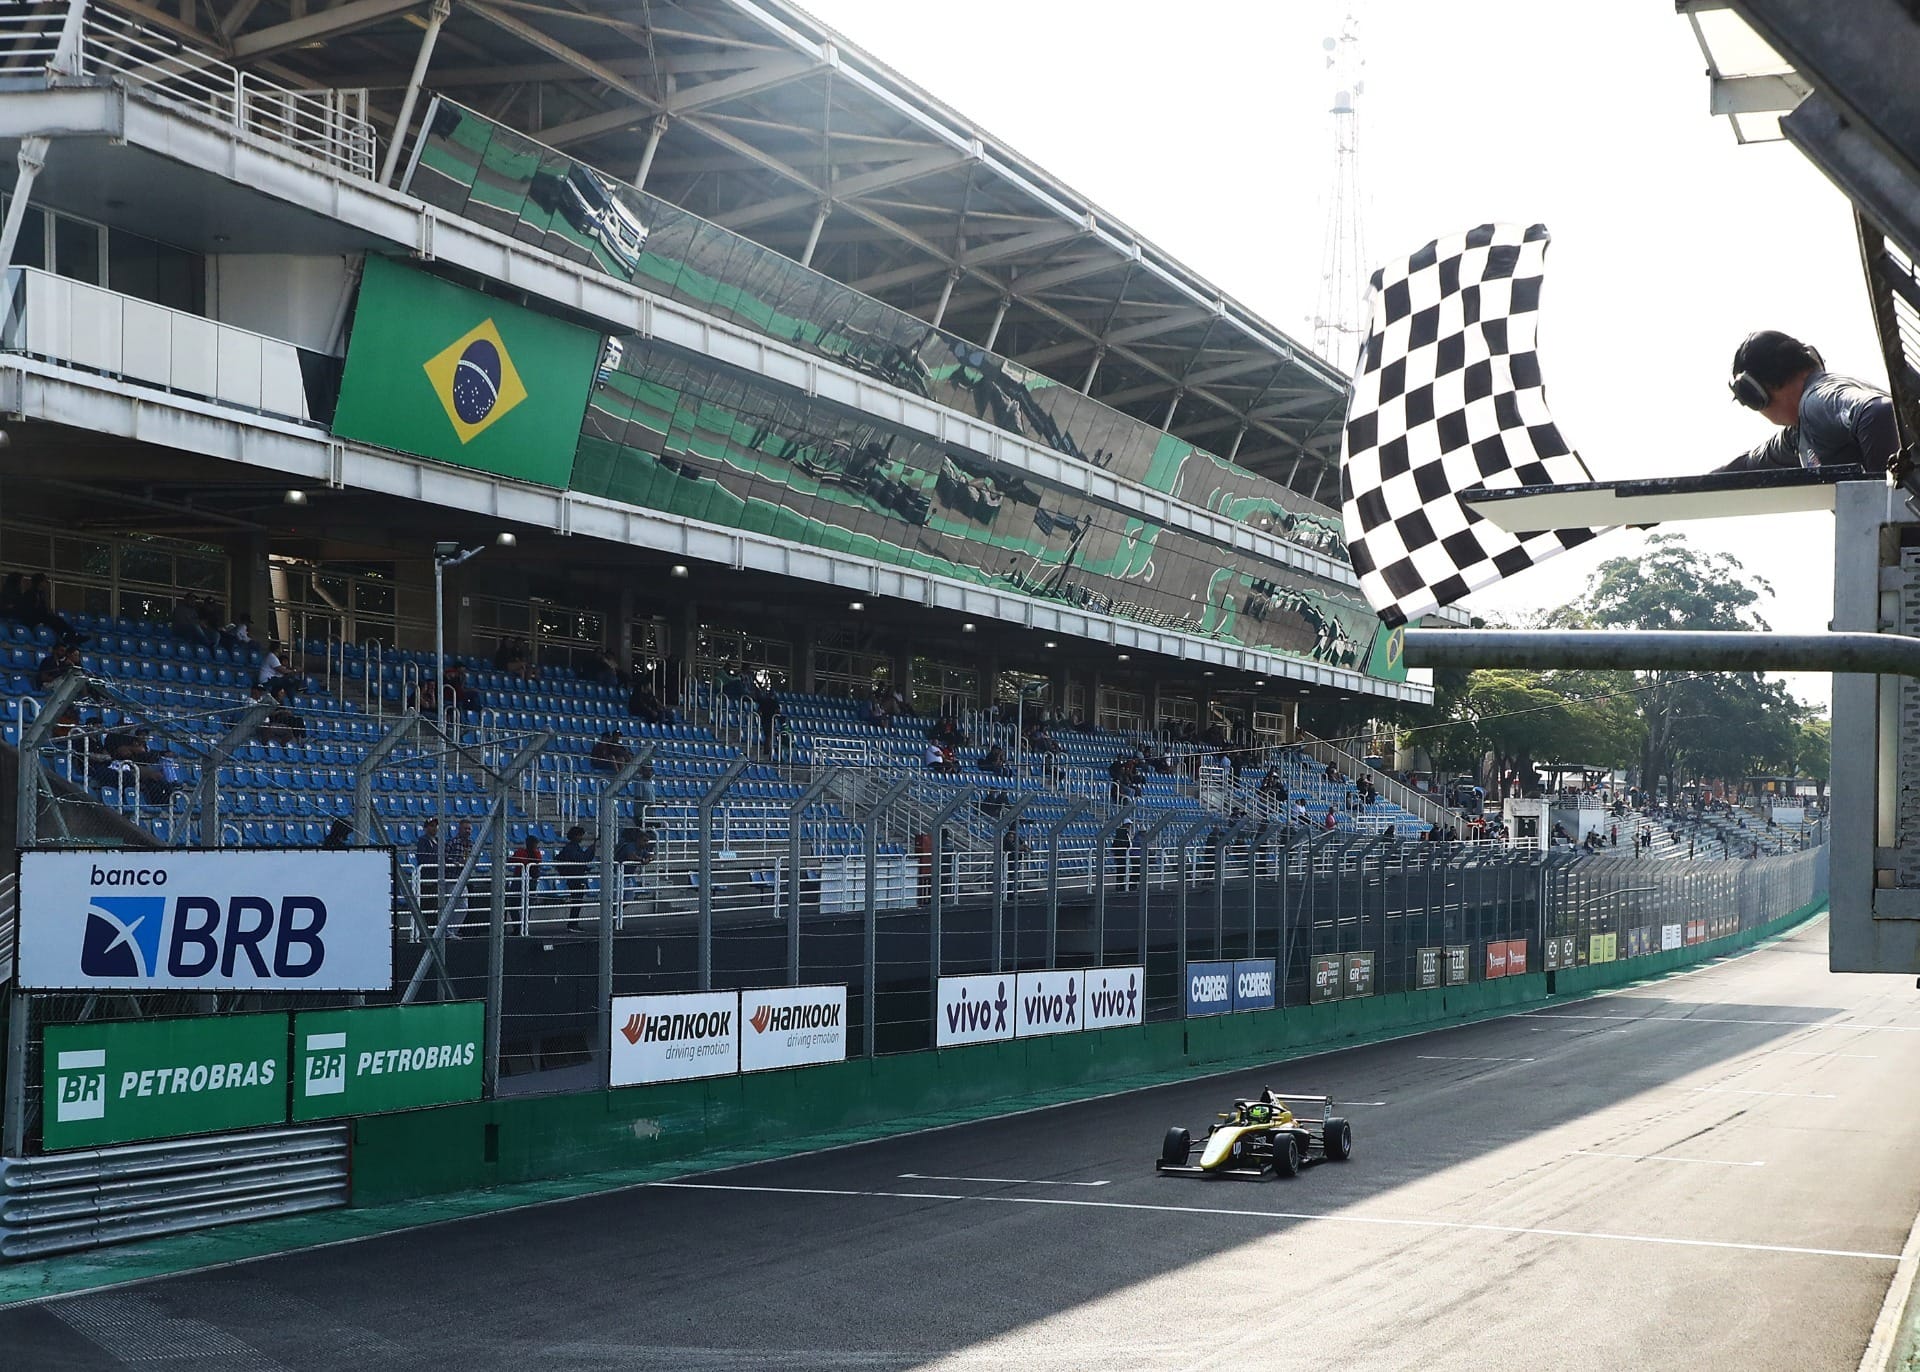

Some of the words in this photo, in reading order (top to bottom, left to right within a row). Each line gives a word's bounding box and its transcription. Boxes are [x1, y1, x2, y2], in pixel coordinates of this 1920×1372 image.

[91, 865, 167, 886] banco
[168, 896, 327, 978] BRB
[1316, 971, 1328, 985] GR
[946, 988, 991, 1034] vivo
[1024, 982, 1063, 1026] vivo
[1091, 979, 1124, 1019] vivo
[666, 1043, 695, 1062] driving
[697, 1041, 730, 1057] emotion
[786, 1034, 811, 1050] driving
[813, 1031, 839, 1046] emotion
[62, 1074, 101, 1103] BR
[119, 1059, 276, 1099] PETROBRAS
[309, 1054, 342, 1081] BR
[356, 1042, 475, 1076] PETROBRAS
